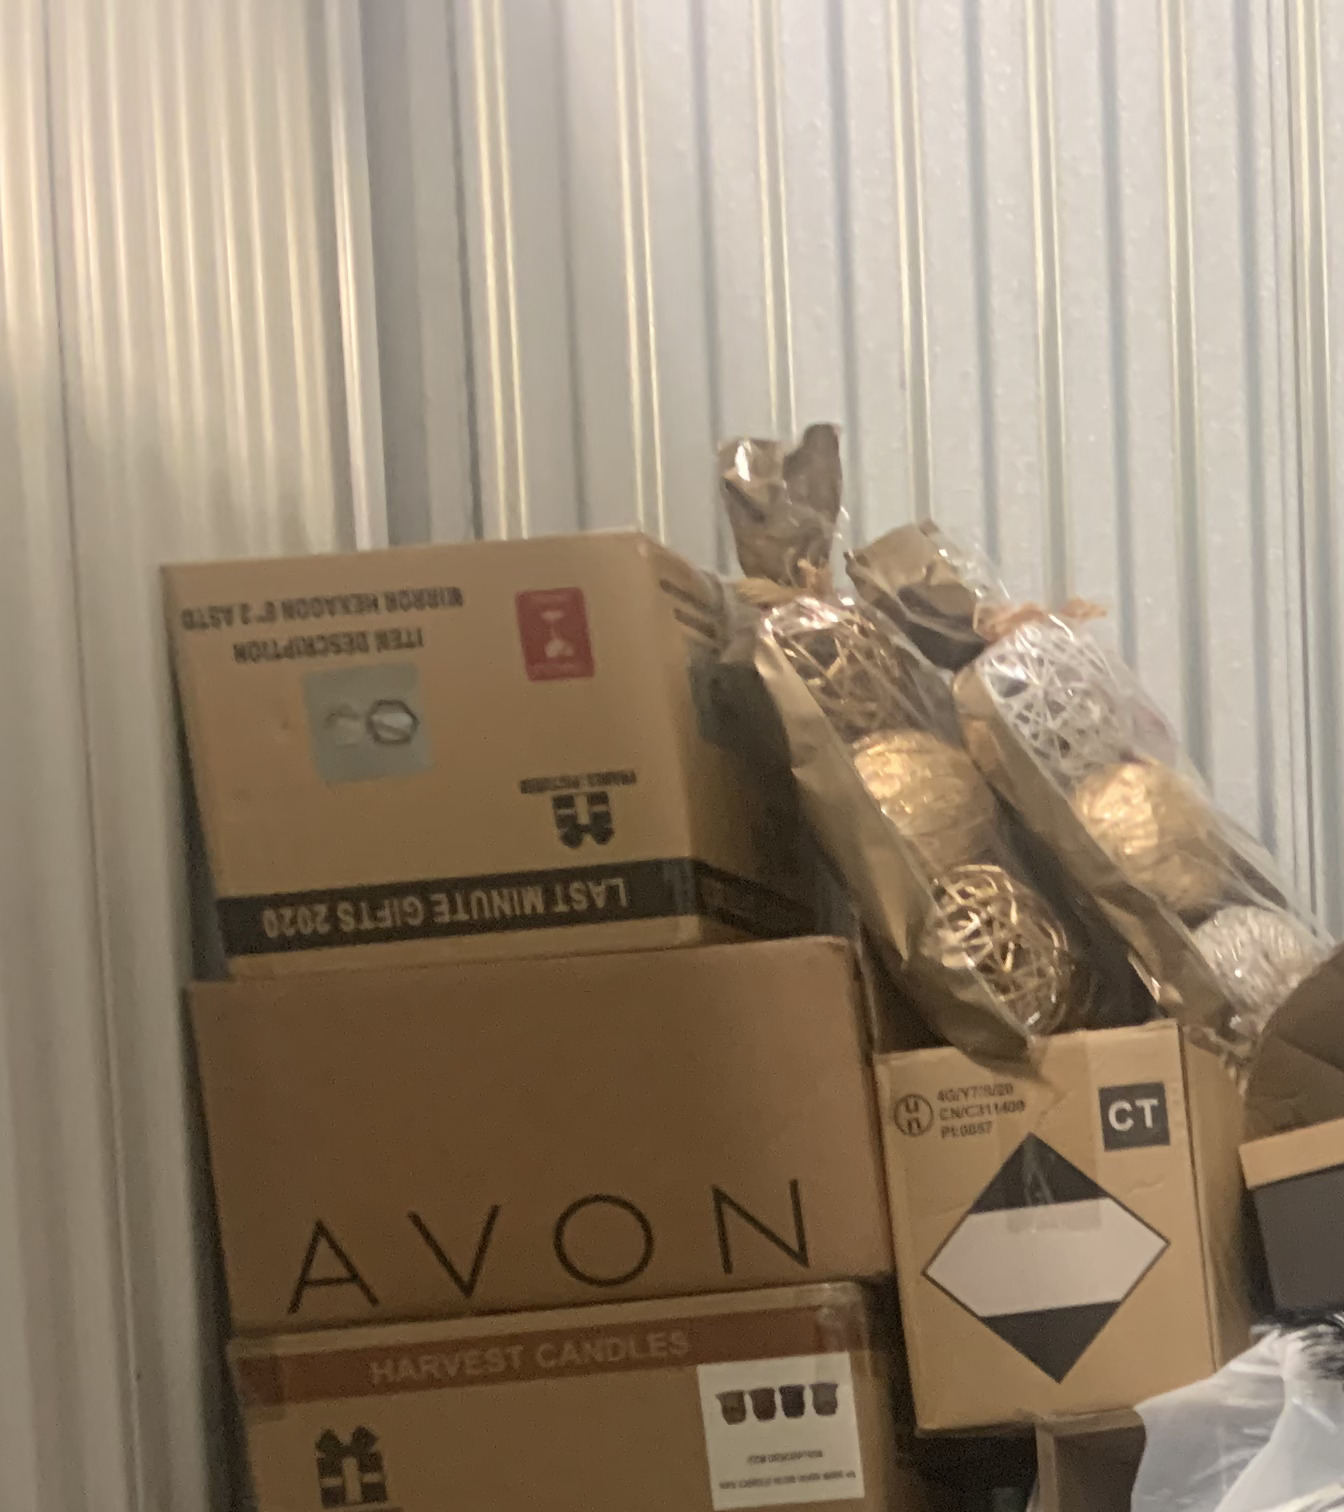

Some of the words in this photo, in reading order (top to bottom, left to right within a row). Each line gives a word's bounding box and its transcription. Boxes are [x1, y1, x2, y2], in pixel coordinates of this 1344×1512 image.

[338, 894, 424, 934] GIFTS
[431, 885, 545, 924] MINUTE
[551, 876, 629, 914] LAST
[261, 903, 331, 940] 2020
[1107, 1098, 1160, 1133] CT
[287, 1178, 811, 1316] AVON
[369, 1343, 525, 1388] HARVEST
[533, 1329, 691, 1371] CANDLES
